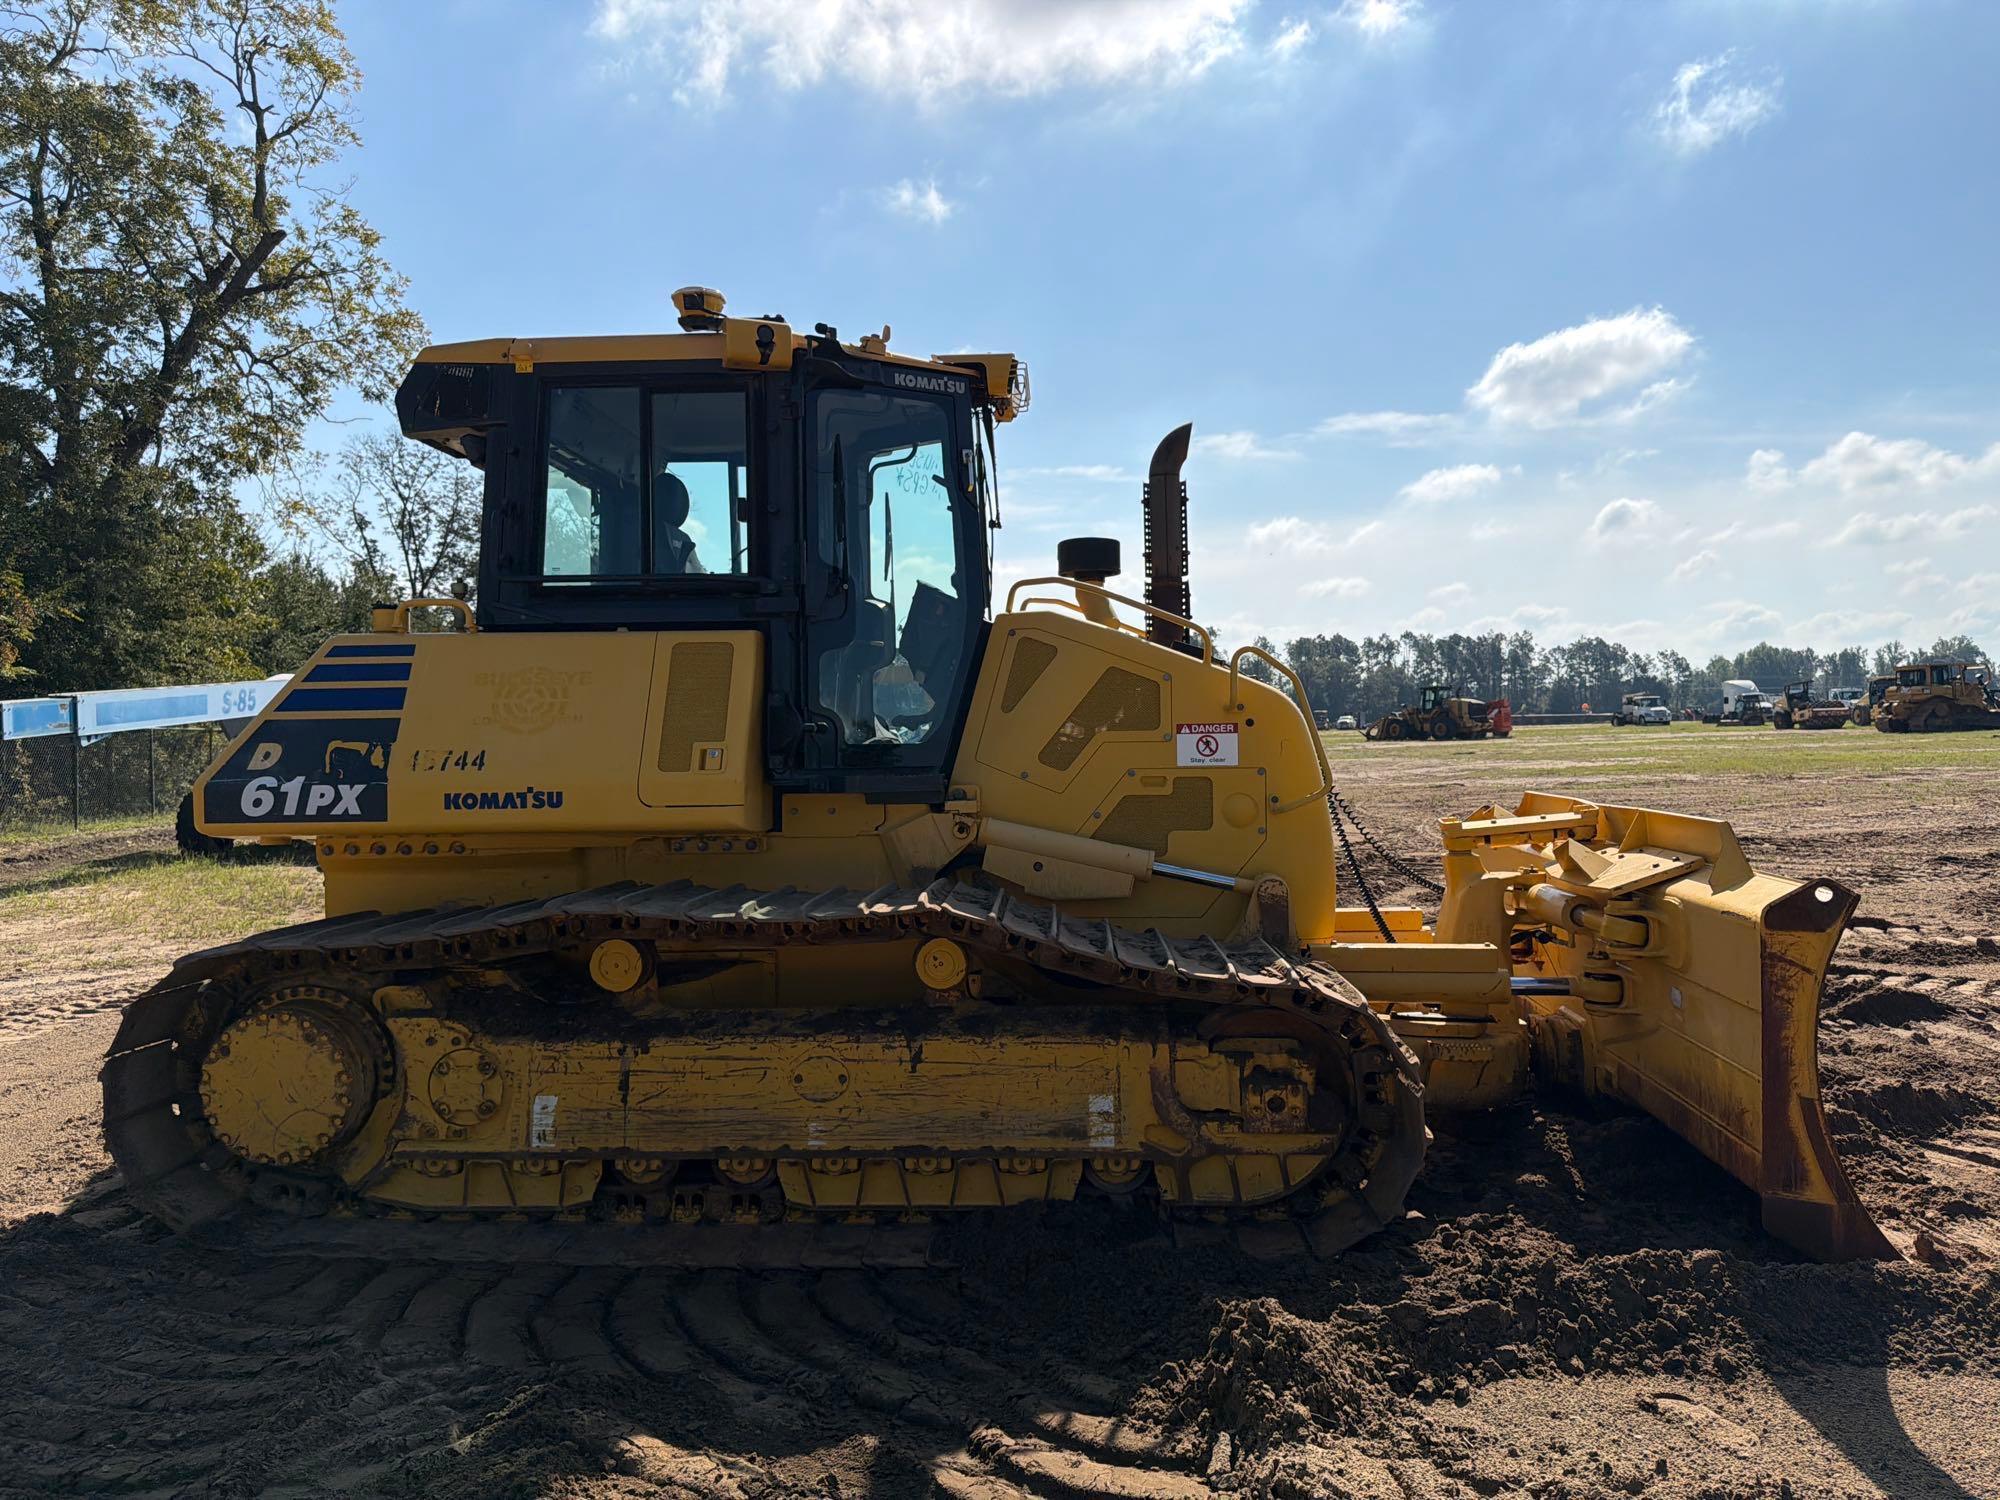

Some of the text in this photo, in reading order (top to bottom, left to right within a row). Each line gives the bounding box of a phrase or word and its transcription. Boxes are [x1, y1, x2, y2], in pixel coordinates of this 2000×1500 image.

[894, 373, 966, 394] KOMATSU
[222, 688, 257, 716] S-85
[1191, 724, 1234, 733] DANGER
[247, 742, 283, 771] D
[240, 776, 367, 818] 61PX
[443, 786, 564, 811] KOMATSU
